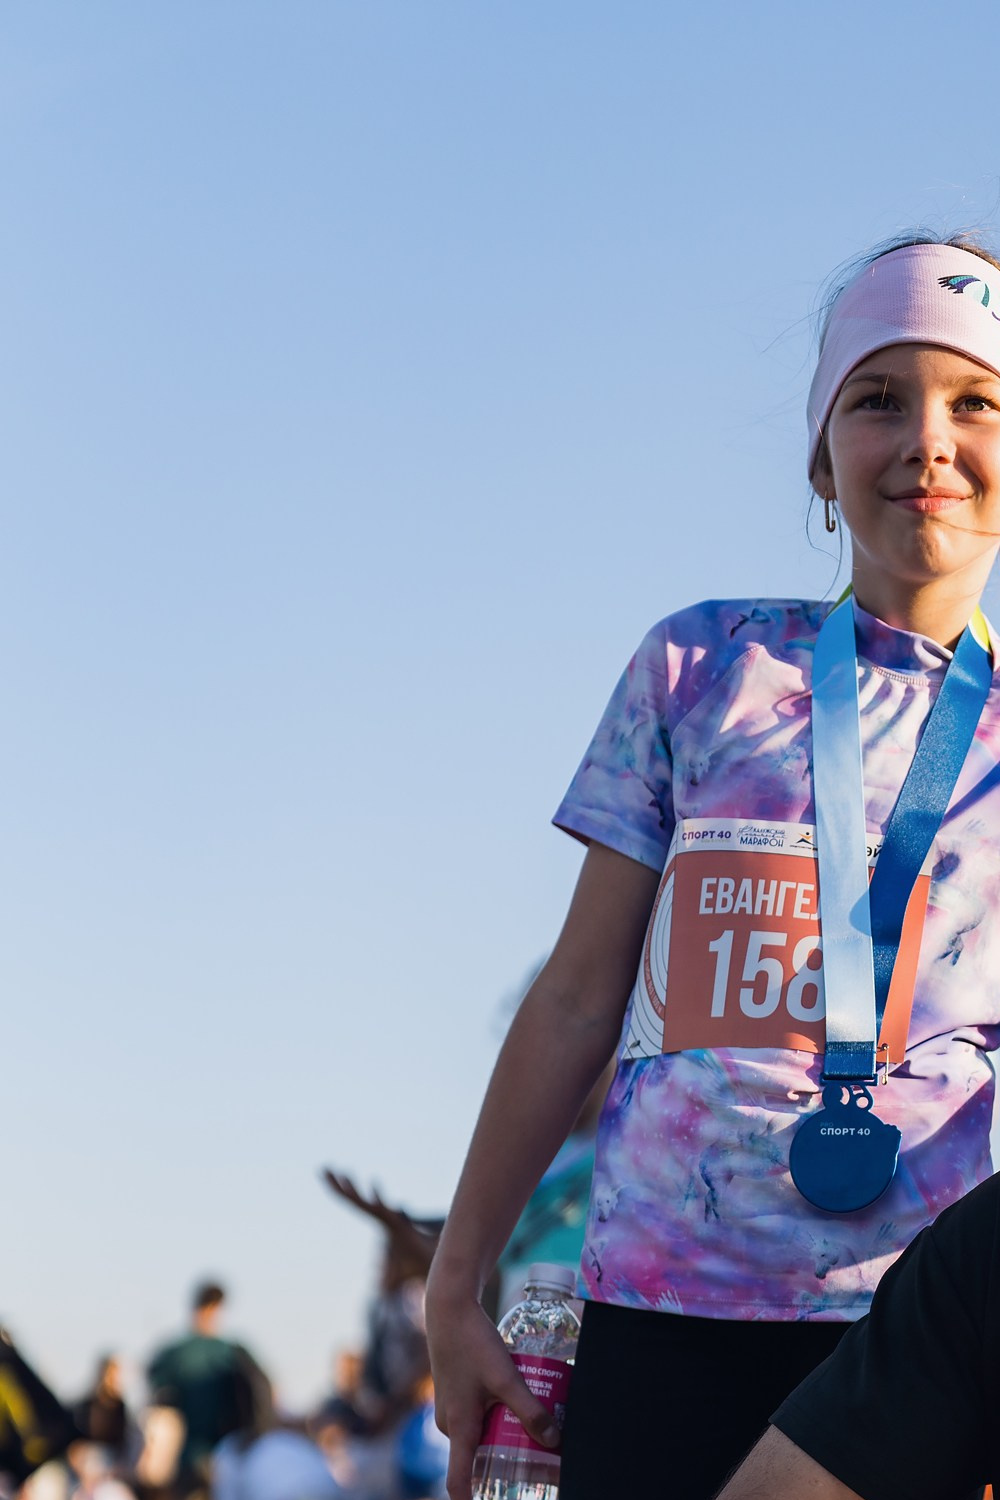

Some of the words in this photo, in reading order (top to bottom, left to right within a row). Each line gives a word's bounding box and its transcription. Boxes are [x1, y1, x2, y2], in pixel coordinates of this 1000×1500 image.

[682, 830, 715, 841] СПОРТ
[717, 830, 732, 839] 40
[740, 836, 784, 848] МАРАФОН
[709, 930, 827, 1022] 158
[820, 1128, 855, 1136] СПОРТ
[857, 1128, 871, 1136] 40
[537, 1367, 563, 1379] СПОРТУ
